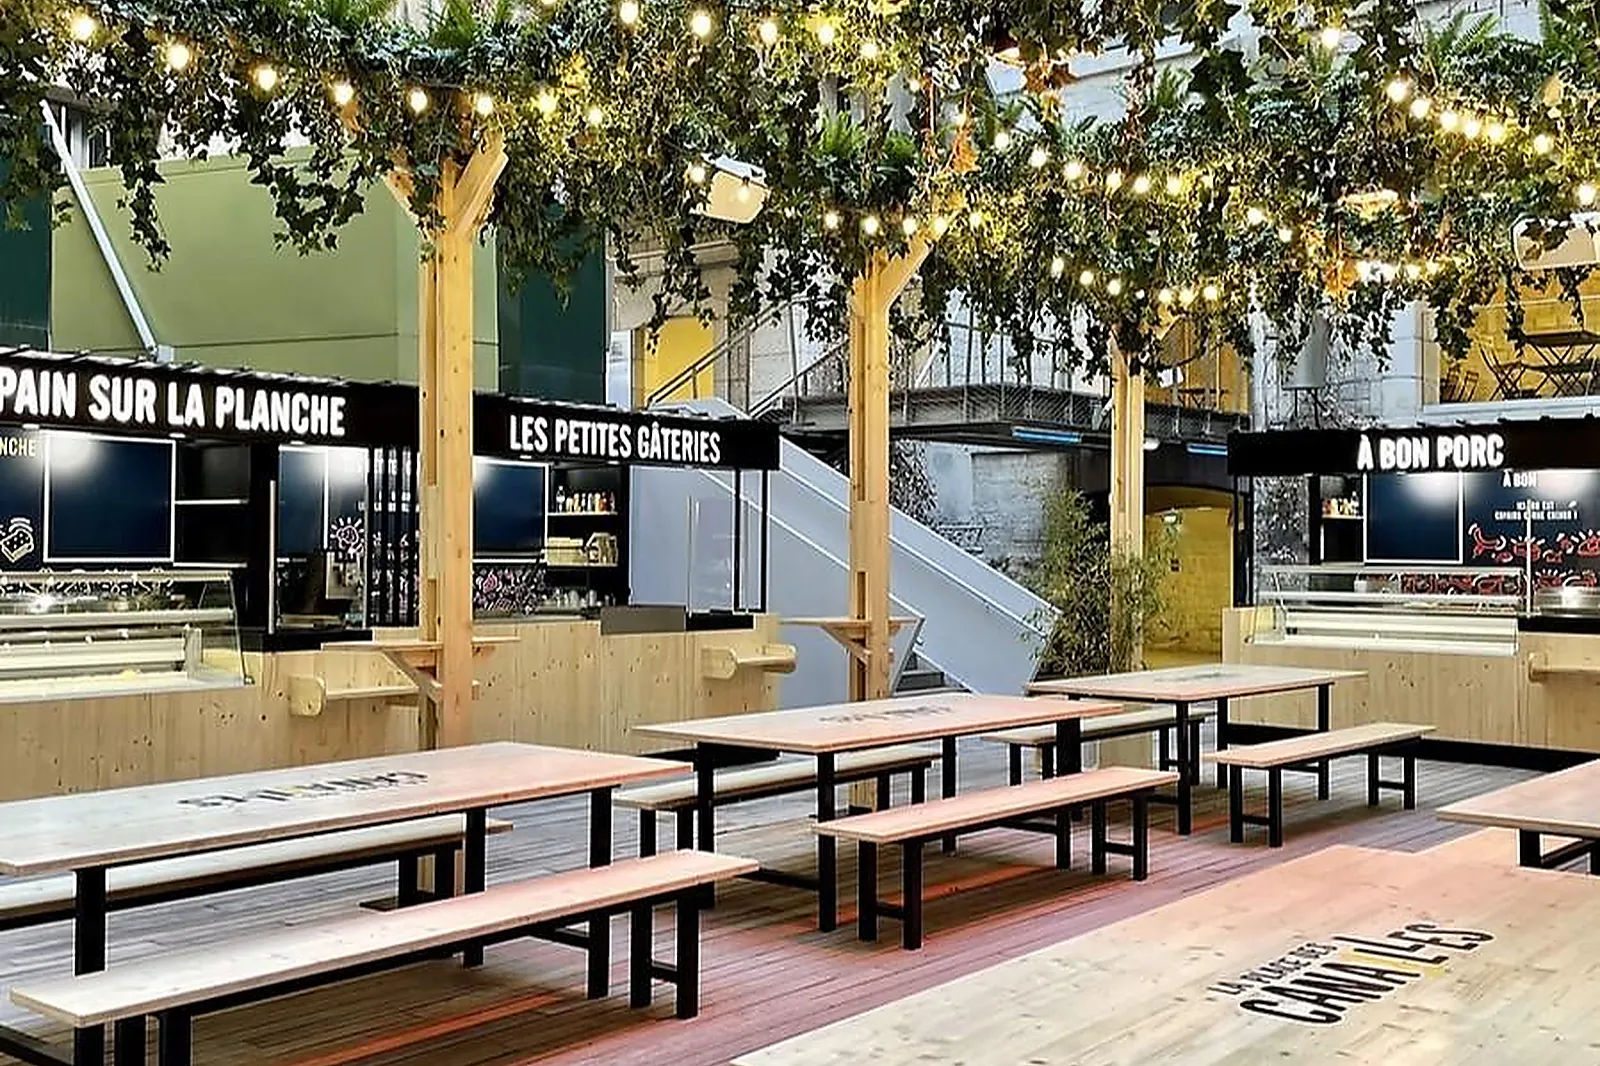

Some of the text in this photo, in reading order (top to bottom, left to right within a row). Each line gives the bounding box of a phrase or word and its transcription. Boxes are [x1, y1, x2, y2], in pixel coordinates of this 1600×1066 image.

[0, 366, 346, 436] PAIN SUR LA PLANCHE
[510, 415, 721, 464] LES PETITES GÂTERIES
[1357, 433, 1505, 470] À BON PORC
[1206, 981, 1255, 995] LA
